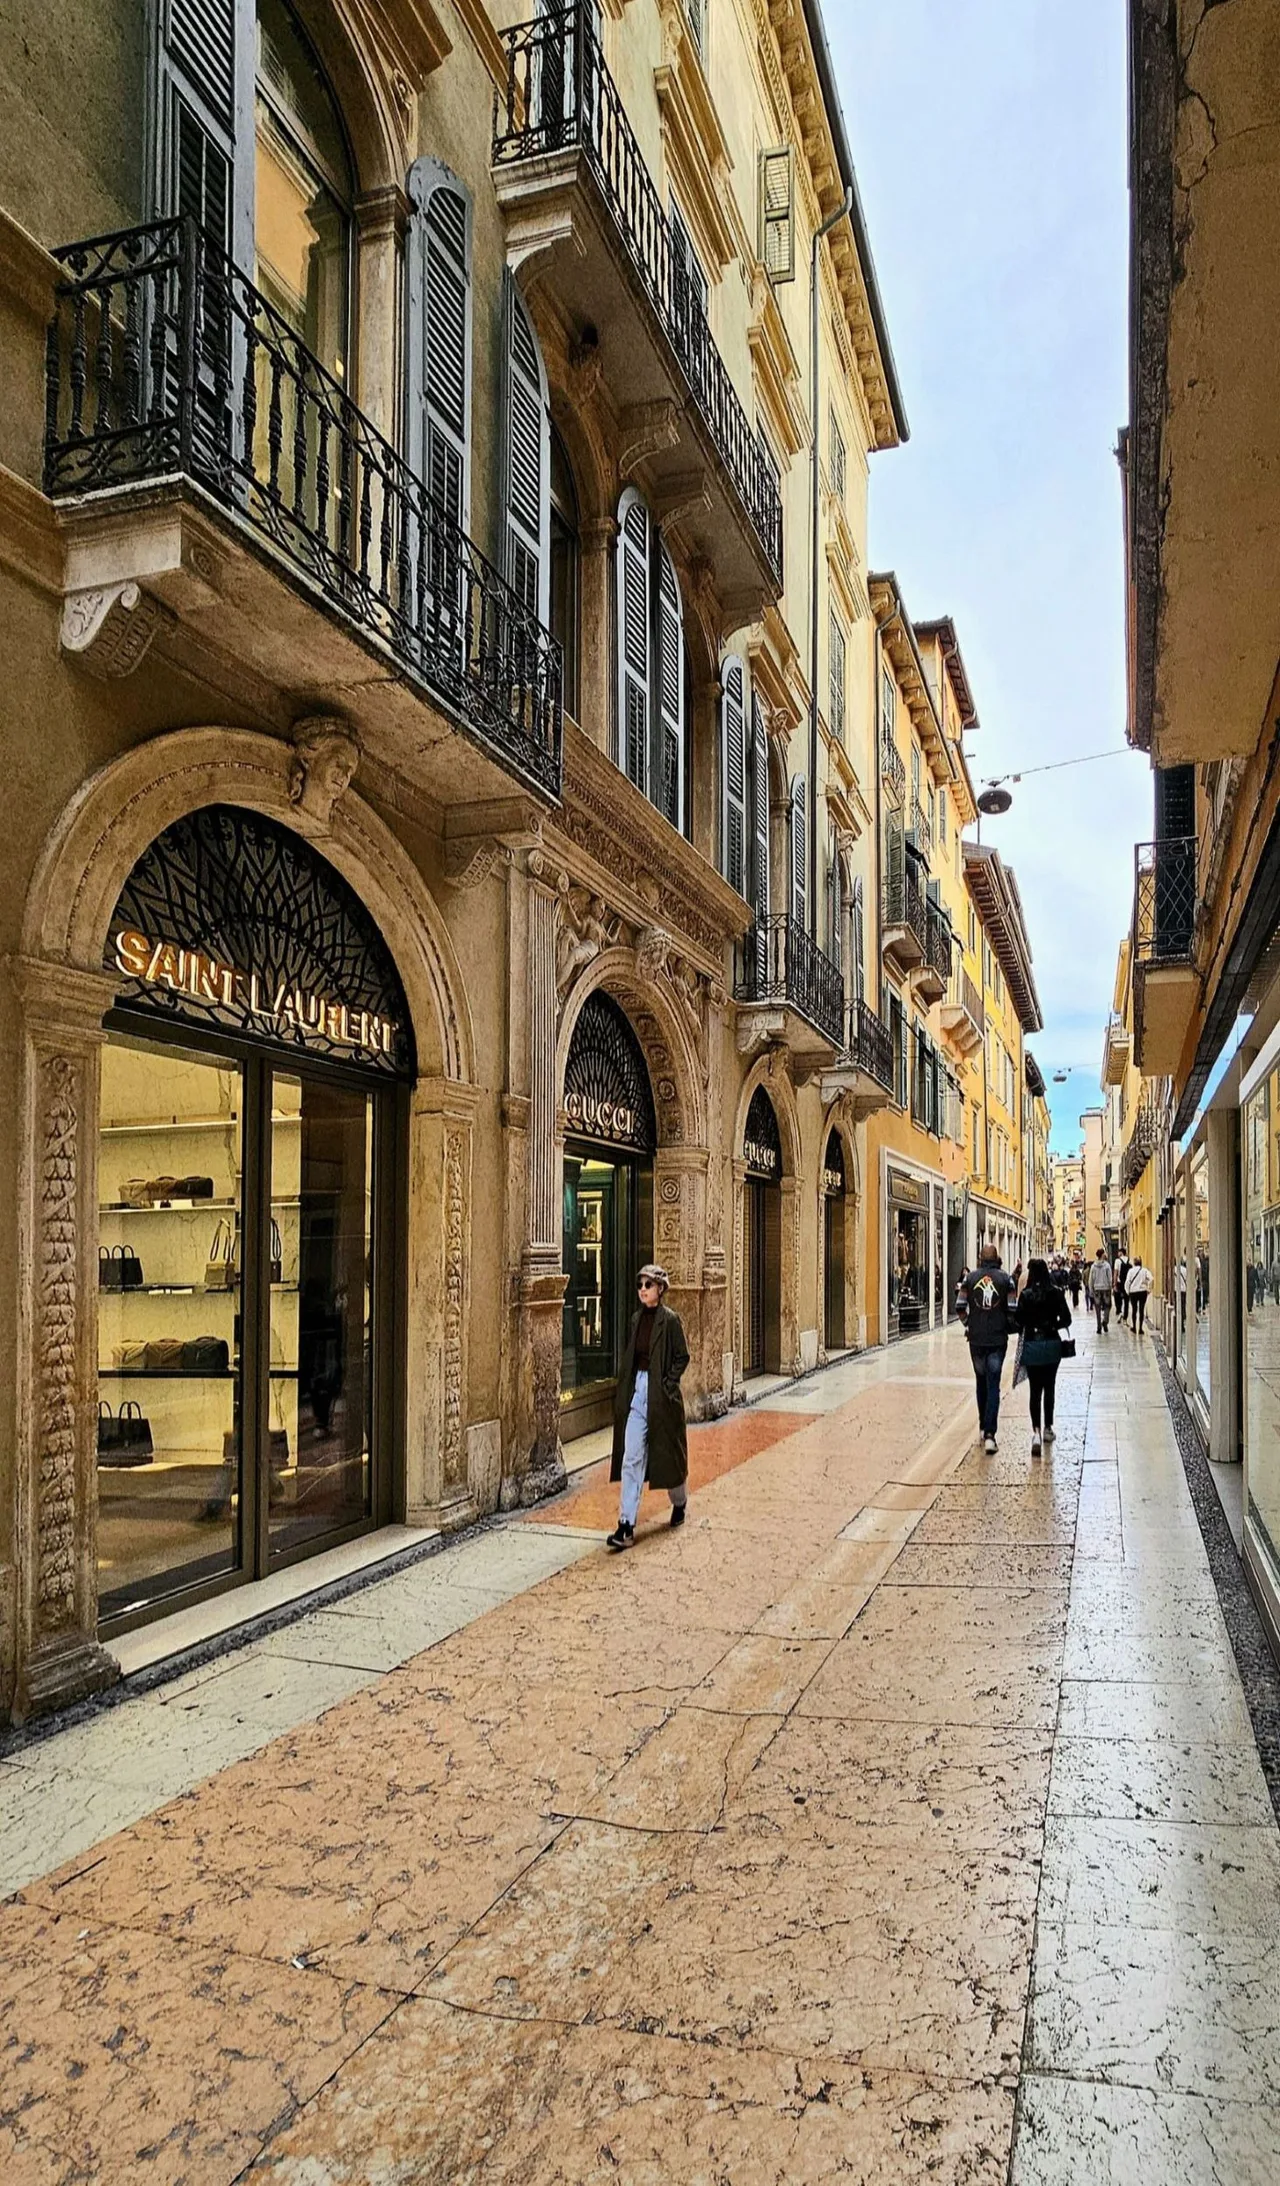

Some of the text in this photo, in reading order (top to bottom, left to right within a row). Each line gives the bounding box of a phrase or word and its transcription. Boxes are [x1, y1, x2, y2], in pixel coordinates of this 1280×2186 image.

[115, 930, 399, 1052] SAINT LAURENT
[564, 1092, 634, 1134] GUCCI
